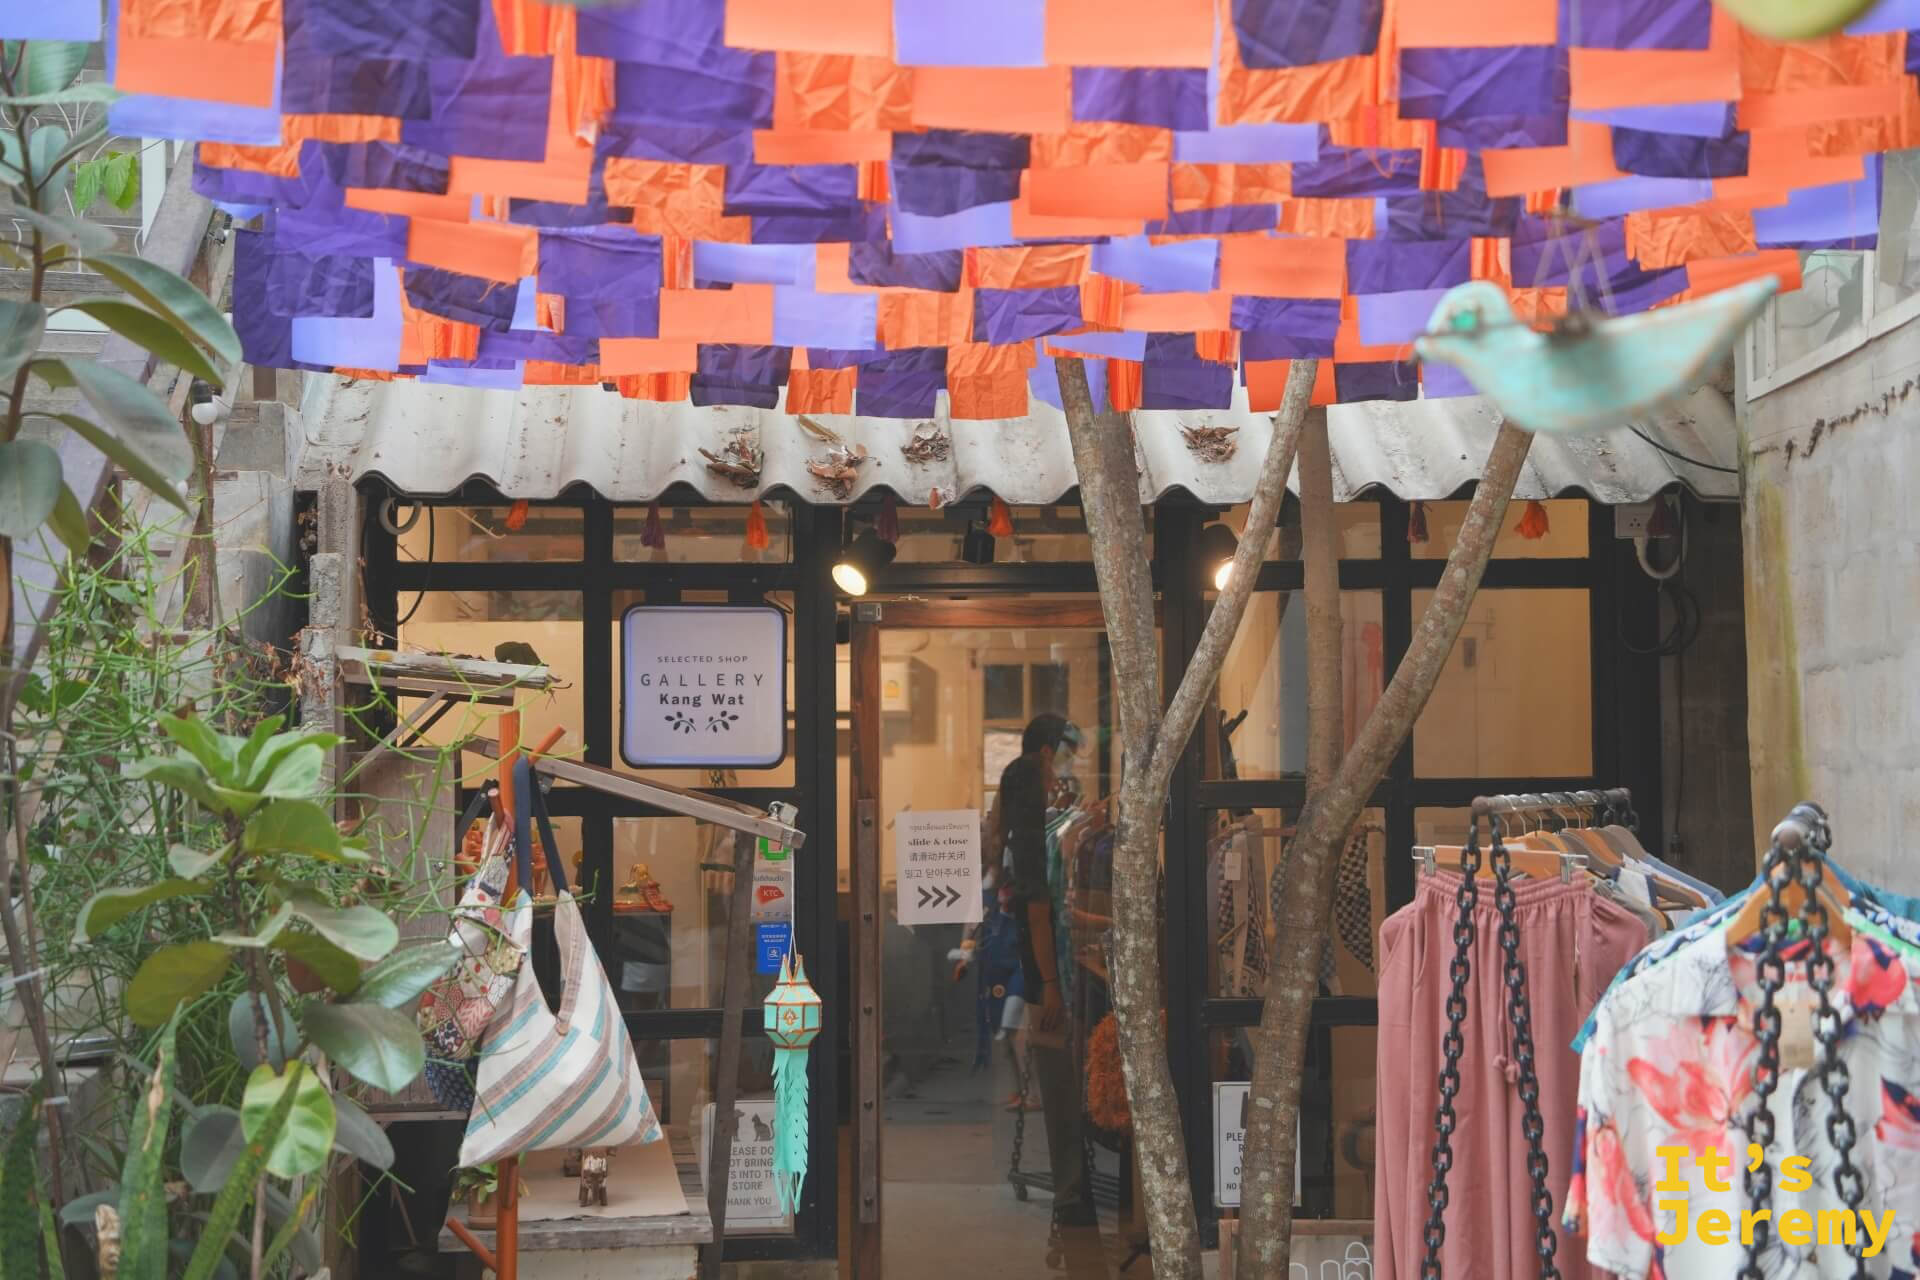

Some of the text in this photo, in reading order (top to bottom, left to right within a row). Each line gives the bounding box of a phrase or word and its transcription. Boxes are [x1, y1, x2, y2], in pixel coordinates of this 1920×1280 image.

[718, 655, 749, 663] SHOP
[640, 673, 764, 687] GALLERY
[659, 693, 744, 708] Kang Wat
[908, 837, 968, 847] slide & close
[925, 867, 971, 879] 닫아주세요
[763, 888, 778, 897] KTC
[1226, 1132, 1244, 1142] PLE
[730, 1146, 774, 1156] EASE DO
[729, 1158, 773, 1168] OT BRING
[740, 1170, 762, 1179] INTO
[732, 1181, 763, 1191] STORE
[1226, 1183, 1237, 1191] NO
[727, 1197, 772, 1206] HANK YOU
